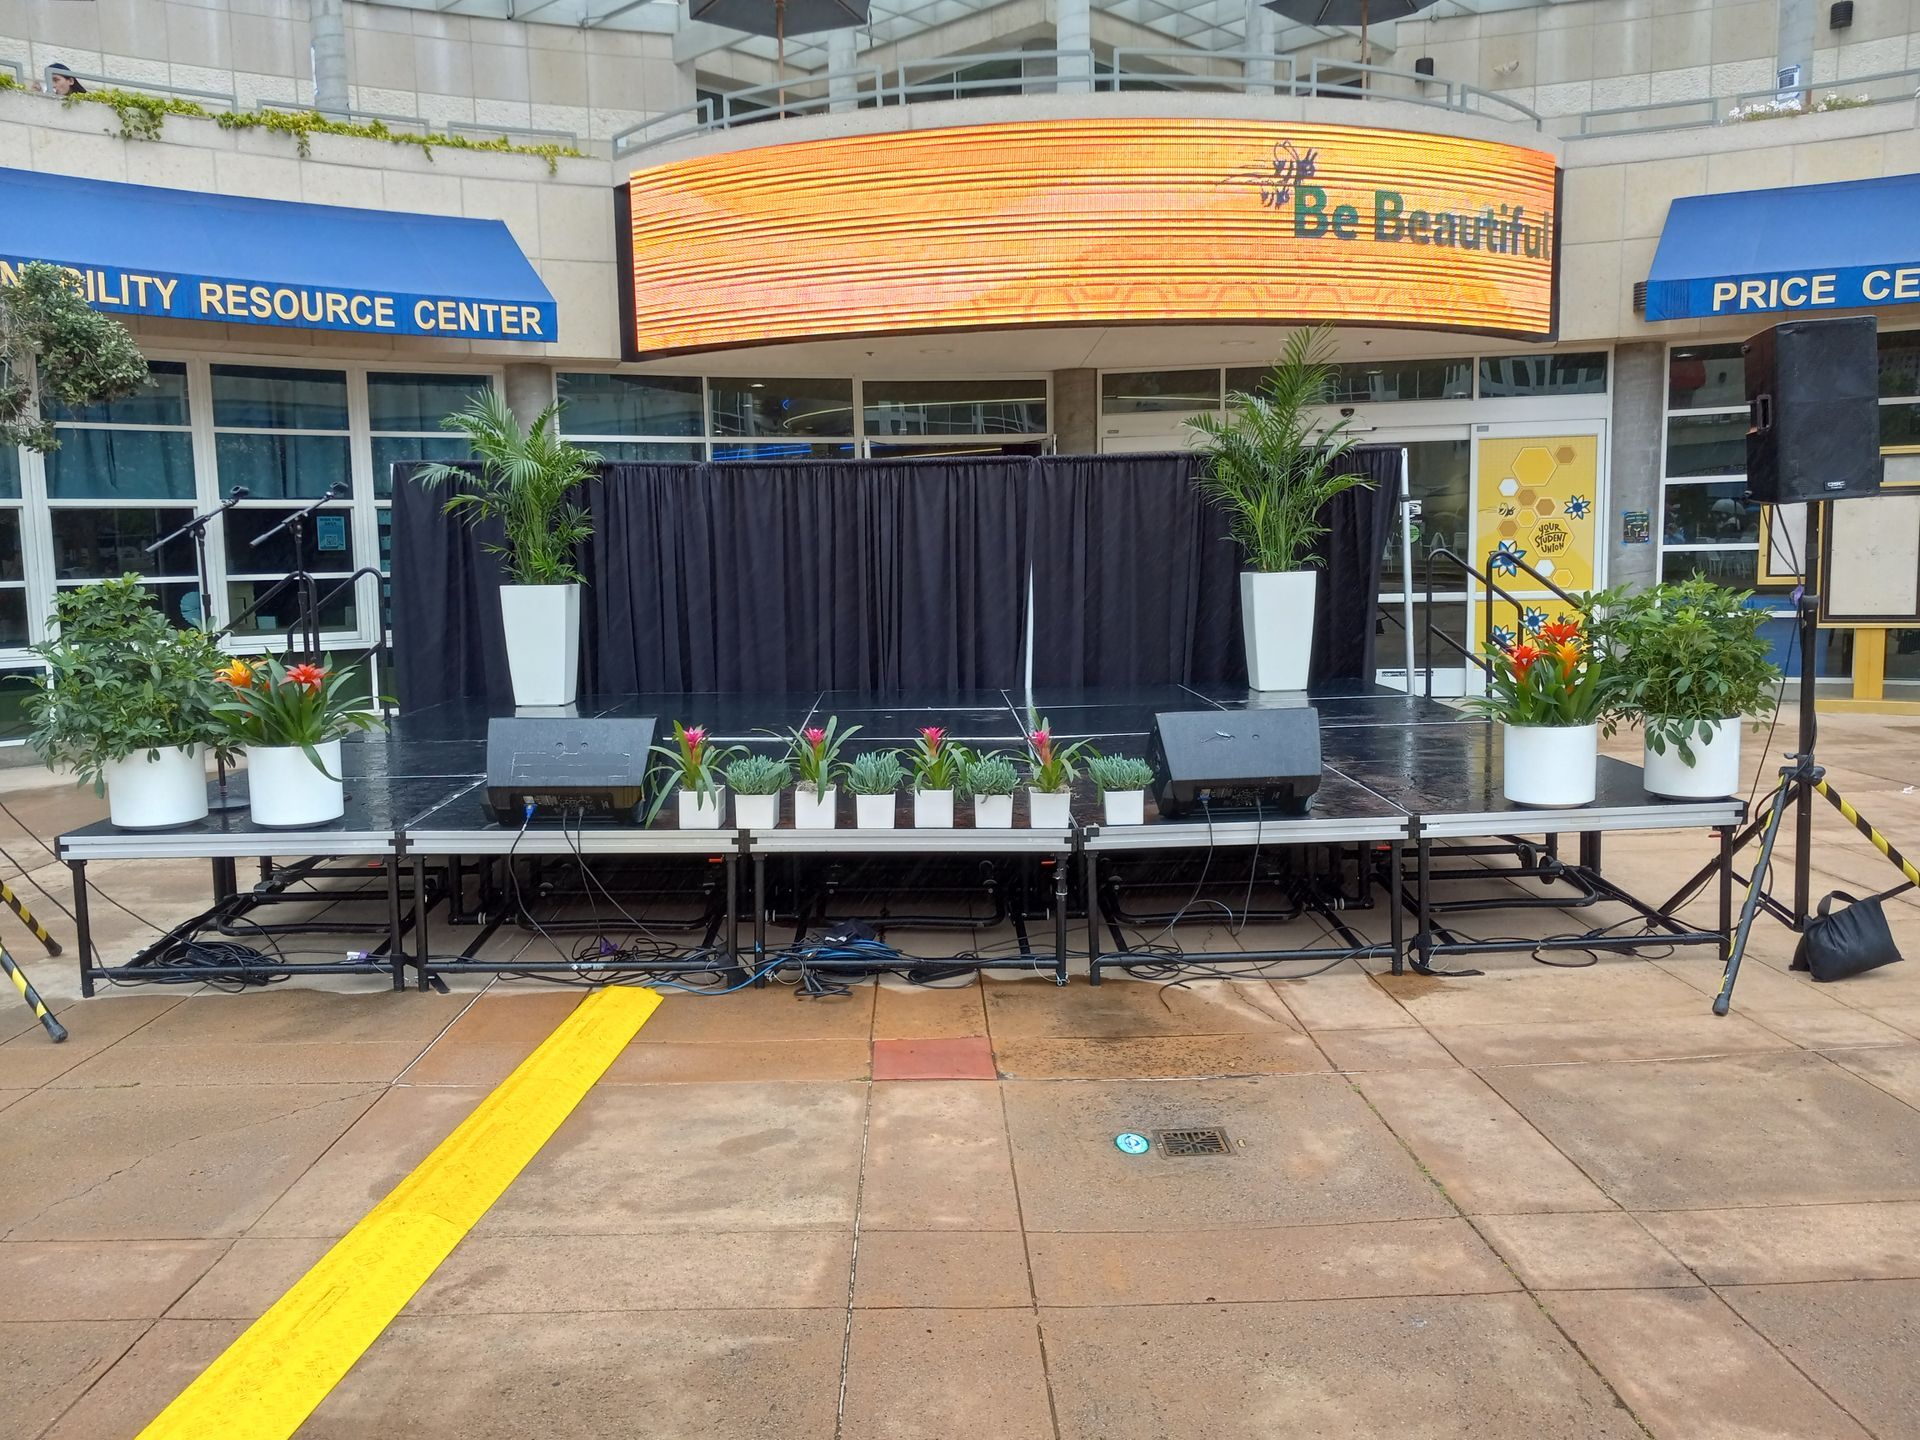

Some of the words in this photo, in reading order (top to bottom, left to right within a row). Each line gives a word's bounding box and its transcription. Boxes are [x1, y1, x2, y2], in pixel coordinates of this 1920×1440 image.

[1294, 185, 1359, 241] Be
[1374, 190, 1550, 261] Beautiful
[1712, 274, 1837, 312] PRICE
[1861, 267, 1920, 301] CE
[199, 282, 395, 328] RESOURCE
[413, 299, 543, 336] CENTER
[1535, 531, 1568, 548] STUDENT
[1538, 523, 1562, 536] YOUR
[1541, 542, 1564, 554] UNION
